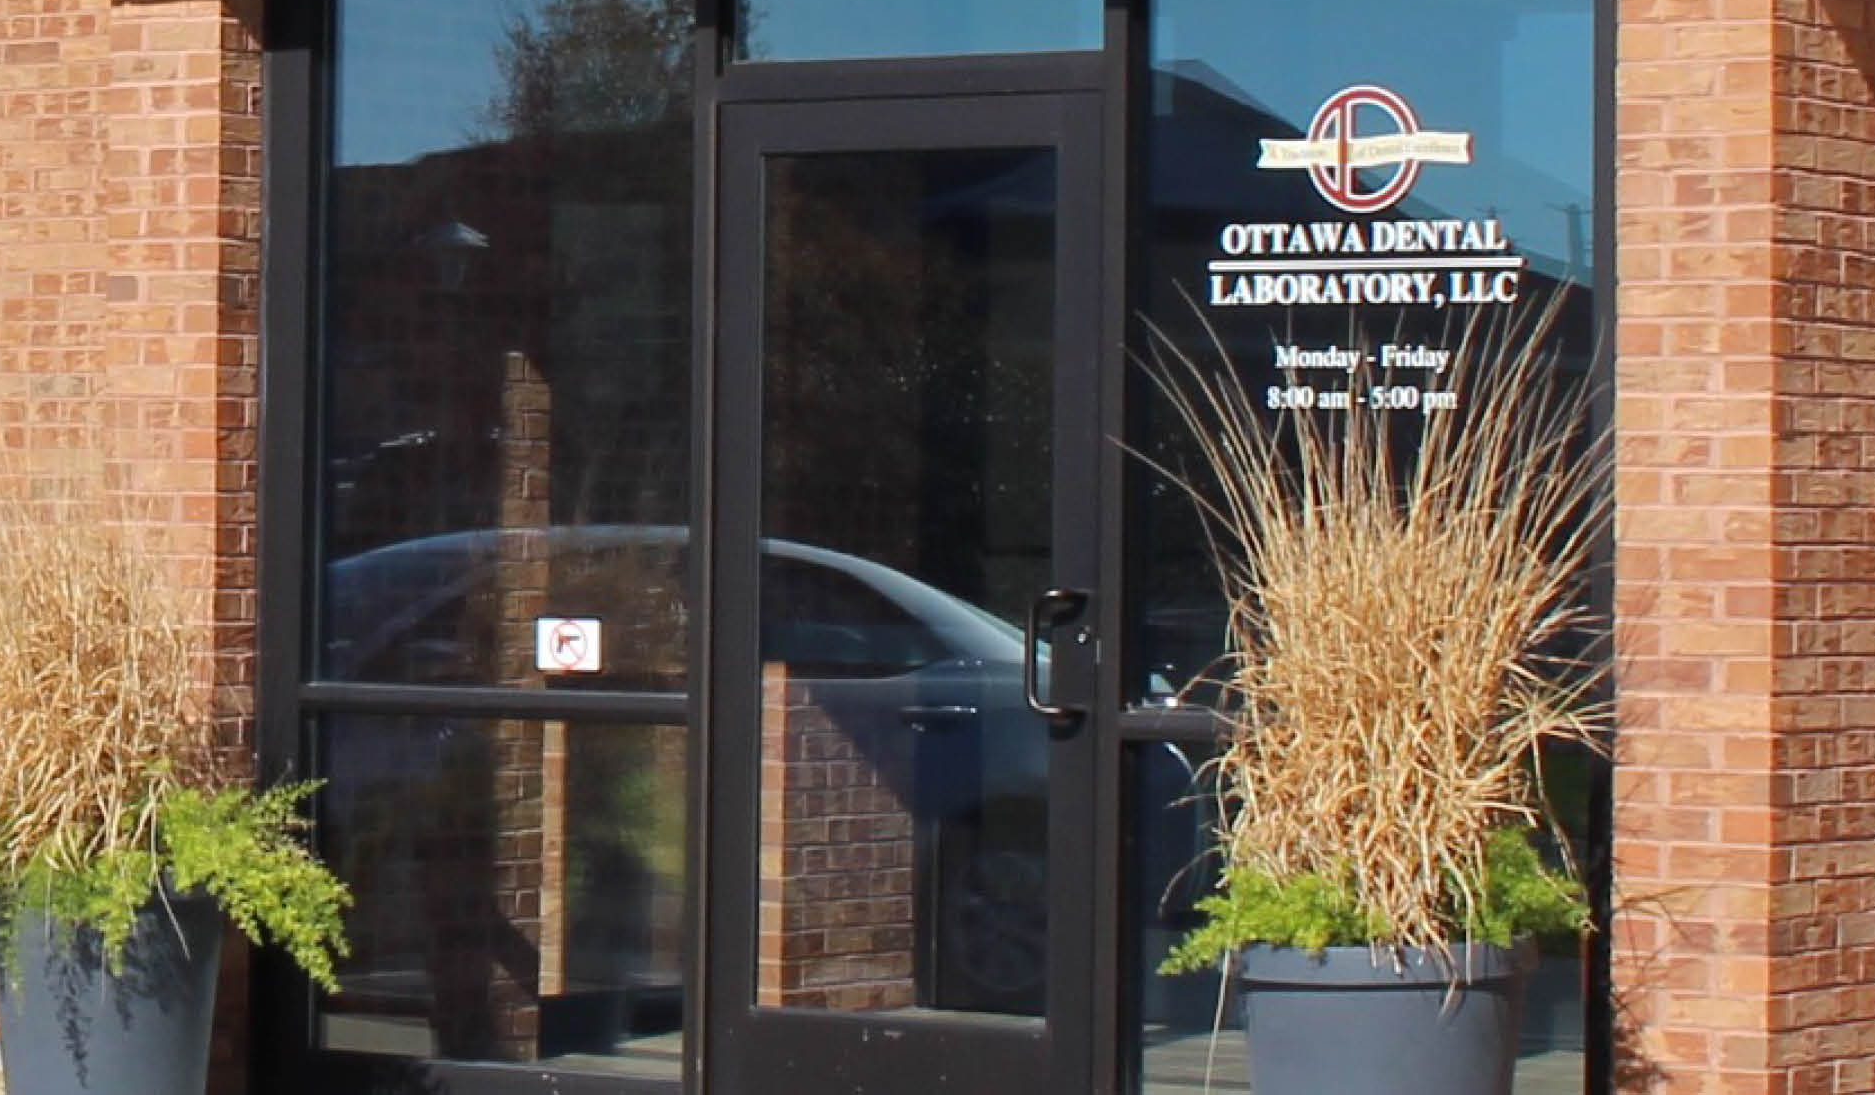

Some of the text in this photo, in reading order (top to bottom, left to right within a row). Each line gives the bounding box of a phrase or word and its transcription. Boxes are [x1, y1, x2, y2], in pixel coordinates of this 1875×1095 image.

[1221, 220, 1507, 254] OTTAWA DENTAL
[1210, 271, 1518, 308] LABORATORY, LLC
[1275, 345, 1361, 373] Monday
[1380, 343, 1450, 373] Friday
[1267, 386, 1314, 409] 8:00
[1318, 392, 1350, 409] am
[1370, 386, 1419, 410] 5:00
[1422, 392, 1458, 416] pm
